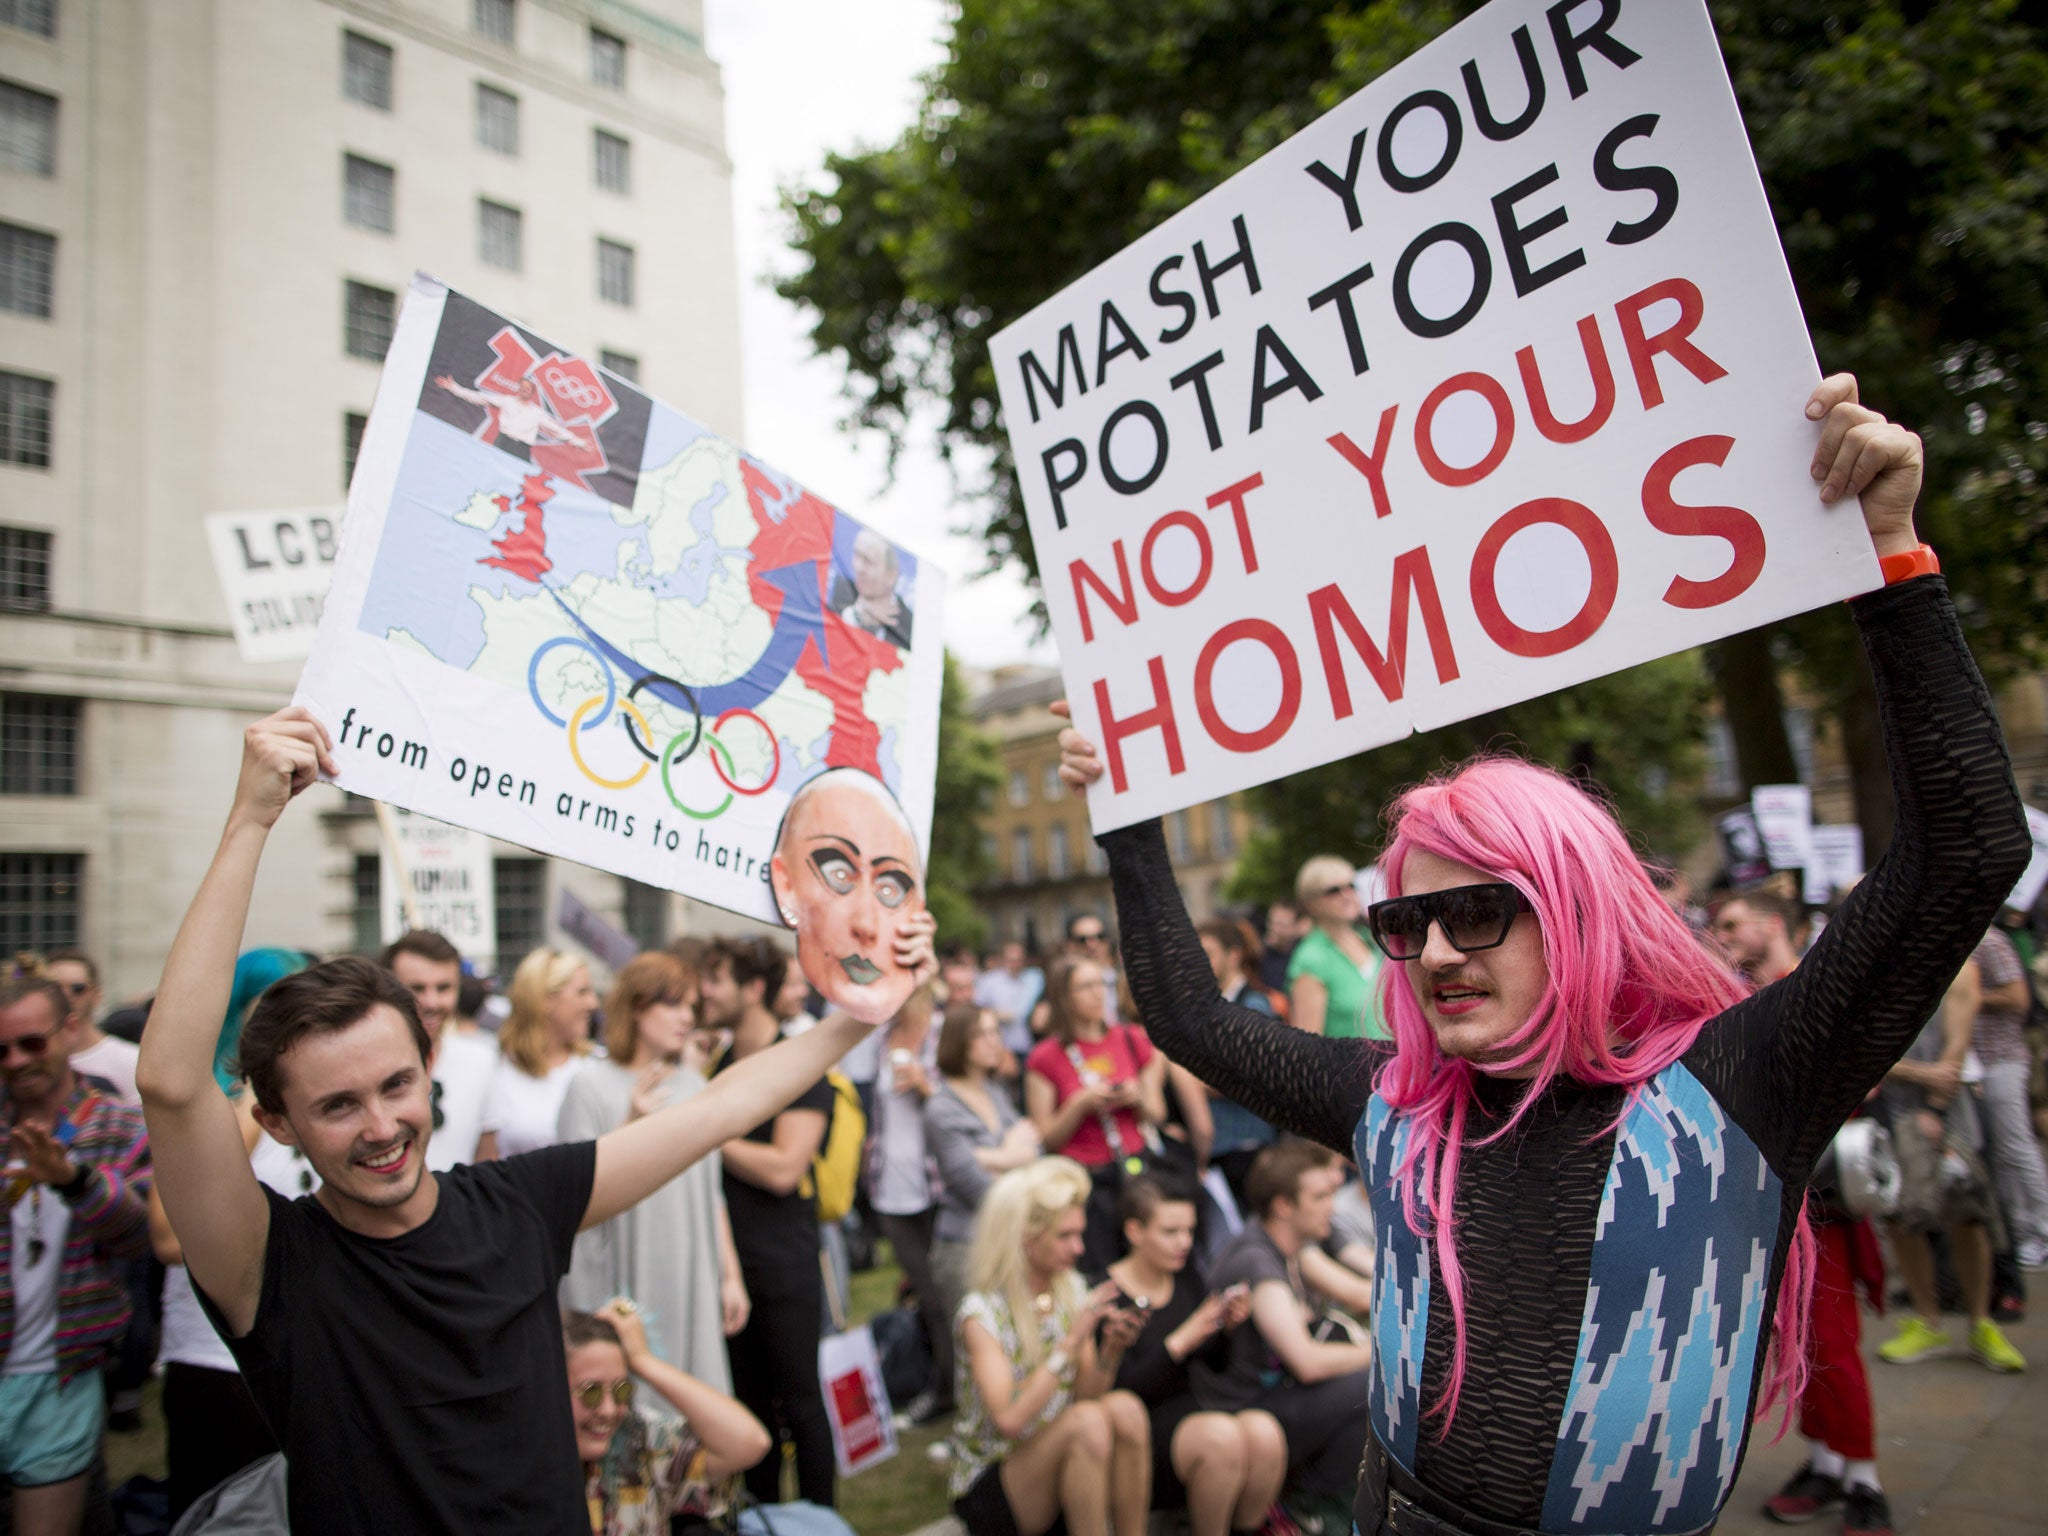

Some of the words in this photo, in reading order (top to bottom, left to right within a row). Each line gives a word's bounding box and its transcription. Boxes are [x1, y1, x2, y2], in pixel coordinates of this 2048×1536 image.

[1018, 213, 1263, 424] MASH
[1304, 0, 1644, 233] YOUR
[1041, 113, 1680, 530] POTATOES
[1068, 471, 1264, 644] NOT
[1327, 277, 1730, 519] YOUR
[1092, 434, 1767, 795] HOMOS
[339, 708, 428, 769] from
[450, 757, 536, 805] open
[557, 790, 635, 837] arms
[654, 818, 680, 851] to
